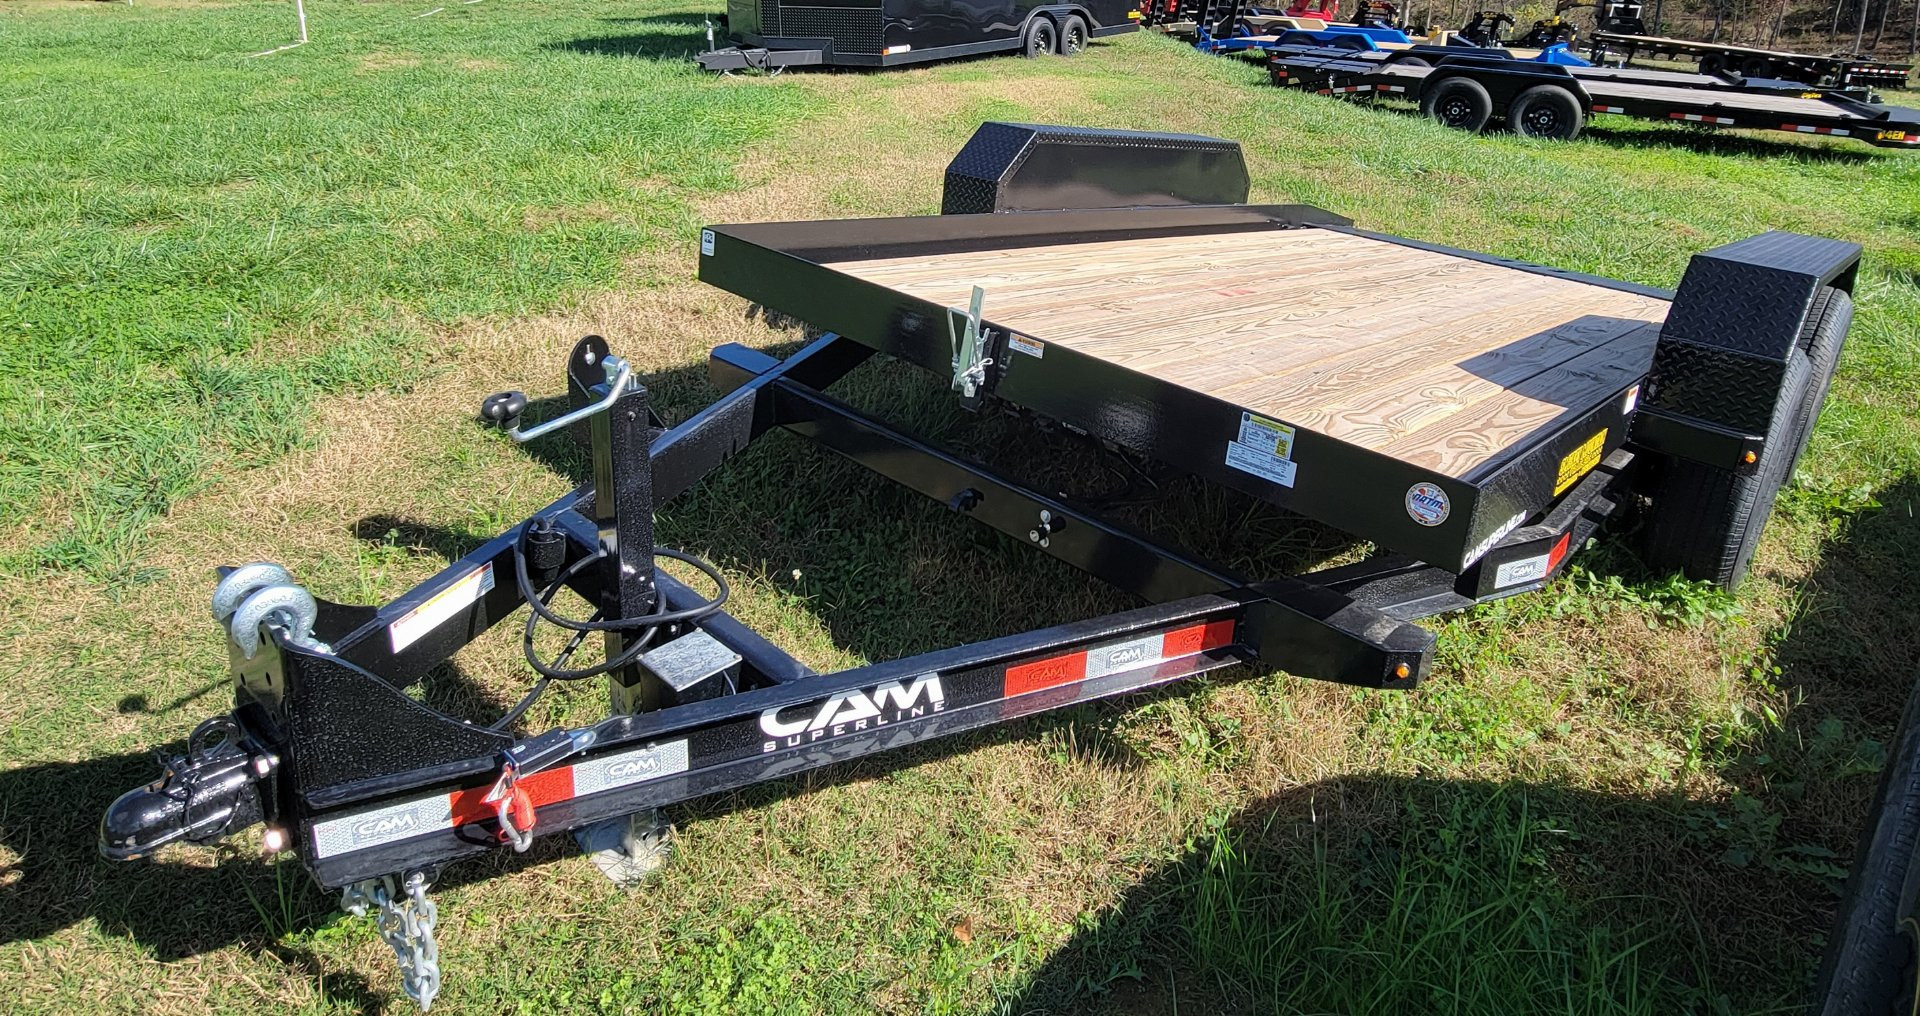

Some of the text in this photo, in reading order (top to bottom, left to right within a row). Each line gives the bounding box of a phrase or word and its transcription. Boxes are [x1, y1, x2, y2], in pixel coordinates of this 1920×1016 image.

[1512, 563, 1534, 574] CAM
[1110, 648, 1142, 662] CAM
[1030, 667, 1065, 682] CAM
[760, 671, 945, 737] CAM
[763, 700, 945, 752] SUPERLINE
[609, 757, 657, 776] CAM
[358, 813, 414, 835] CAM
